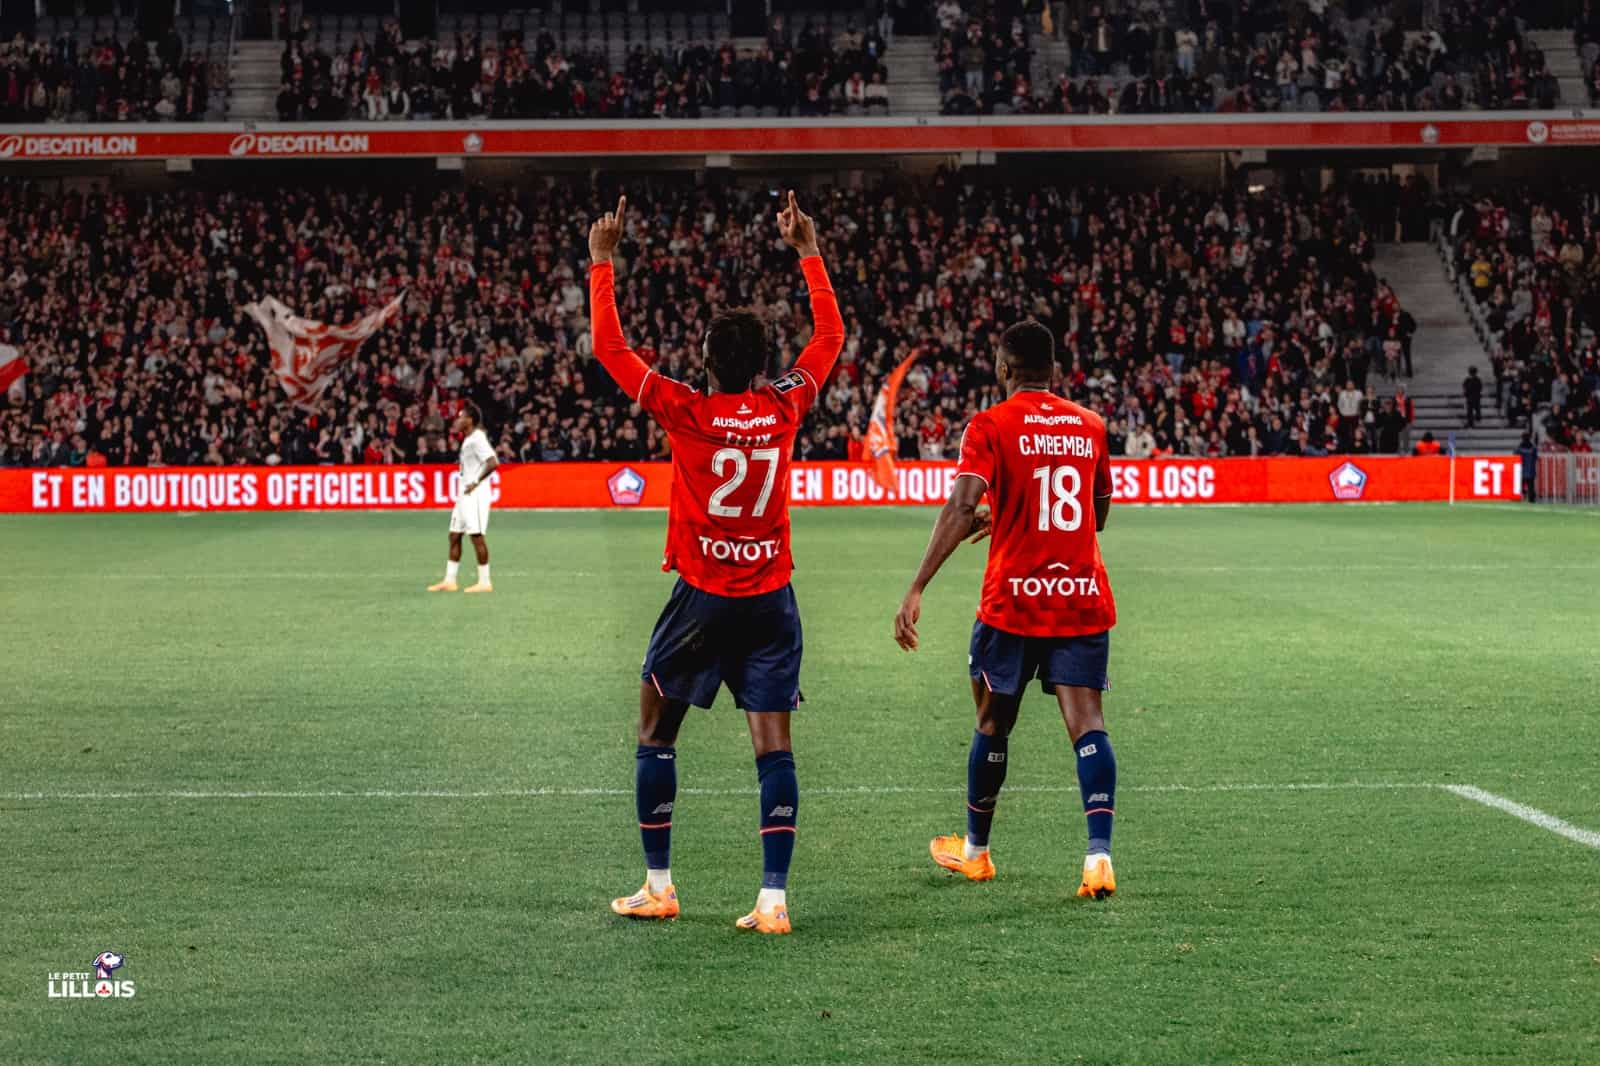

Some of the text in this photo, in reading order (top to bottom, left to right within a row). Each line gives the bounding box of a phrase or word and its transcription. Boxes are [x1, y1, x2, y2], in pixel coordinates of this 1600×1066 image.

[25, 136, 137, 155] DECATHLON
[257, 135, 369, 153] DECATHLON
[1018, 433, 1094, 460] C.MBEMBA
[32, 469, 501, 509] ET EN BOUTIQUES OFFICIELLES LOC
[707, 447, 780, 518] 27
[790, 468, 823, 501] EN
[1148, 464, 1216, 499] LOSC
[1473, 459, 1504, 496] ET
[1032, 464, 1083, 532] 18
[1008, 575, 1100, 597] TOYOTA
